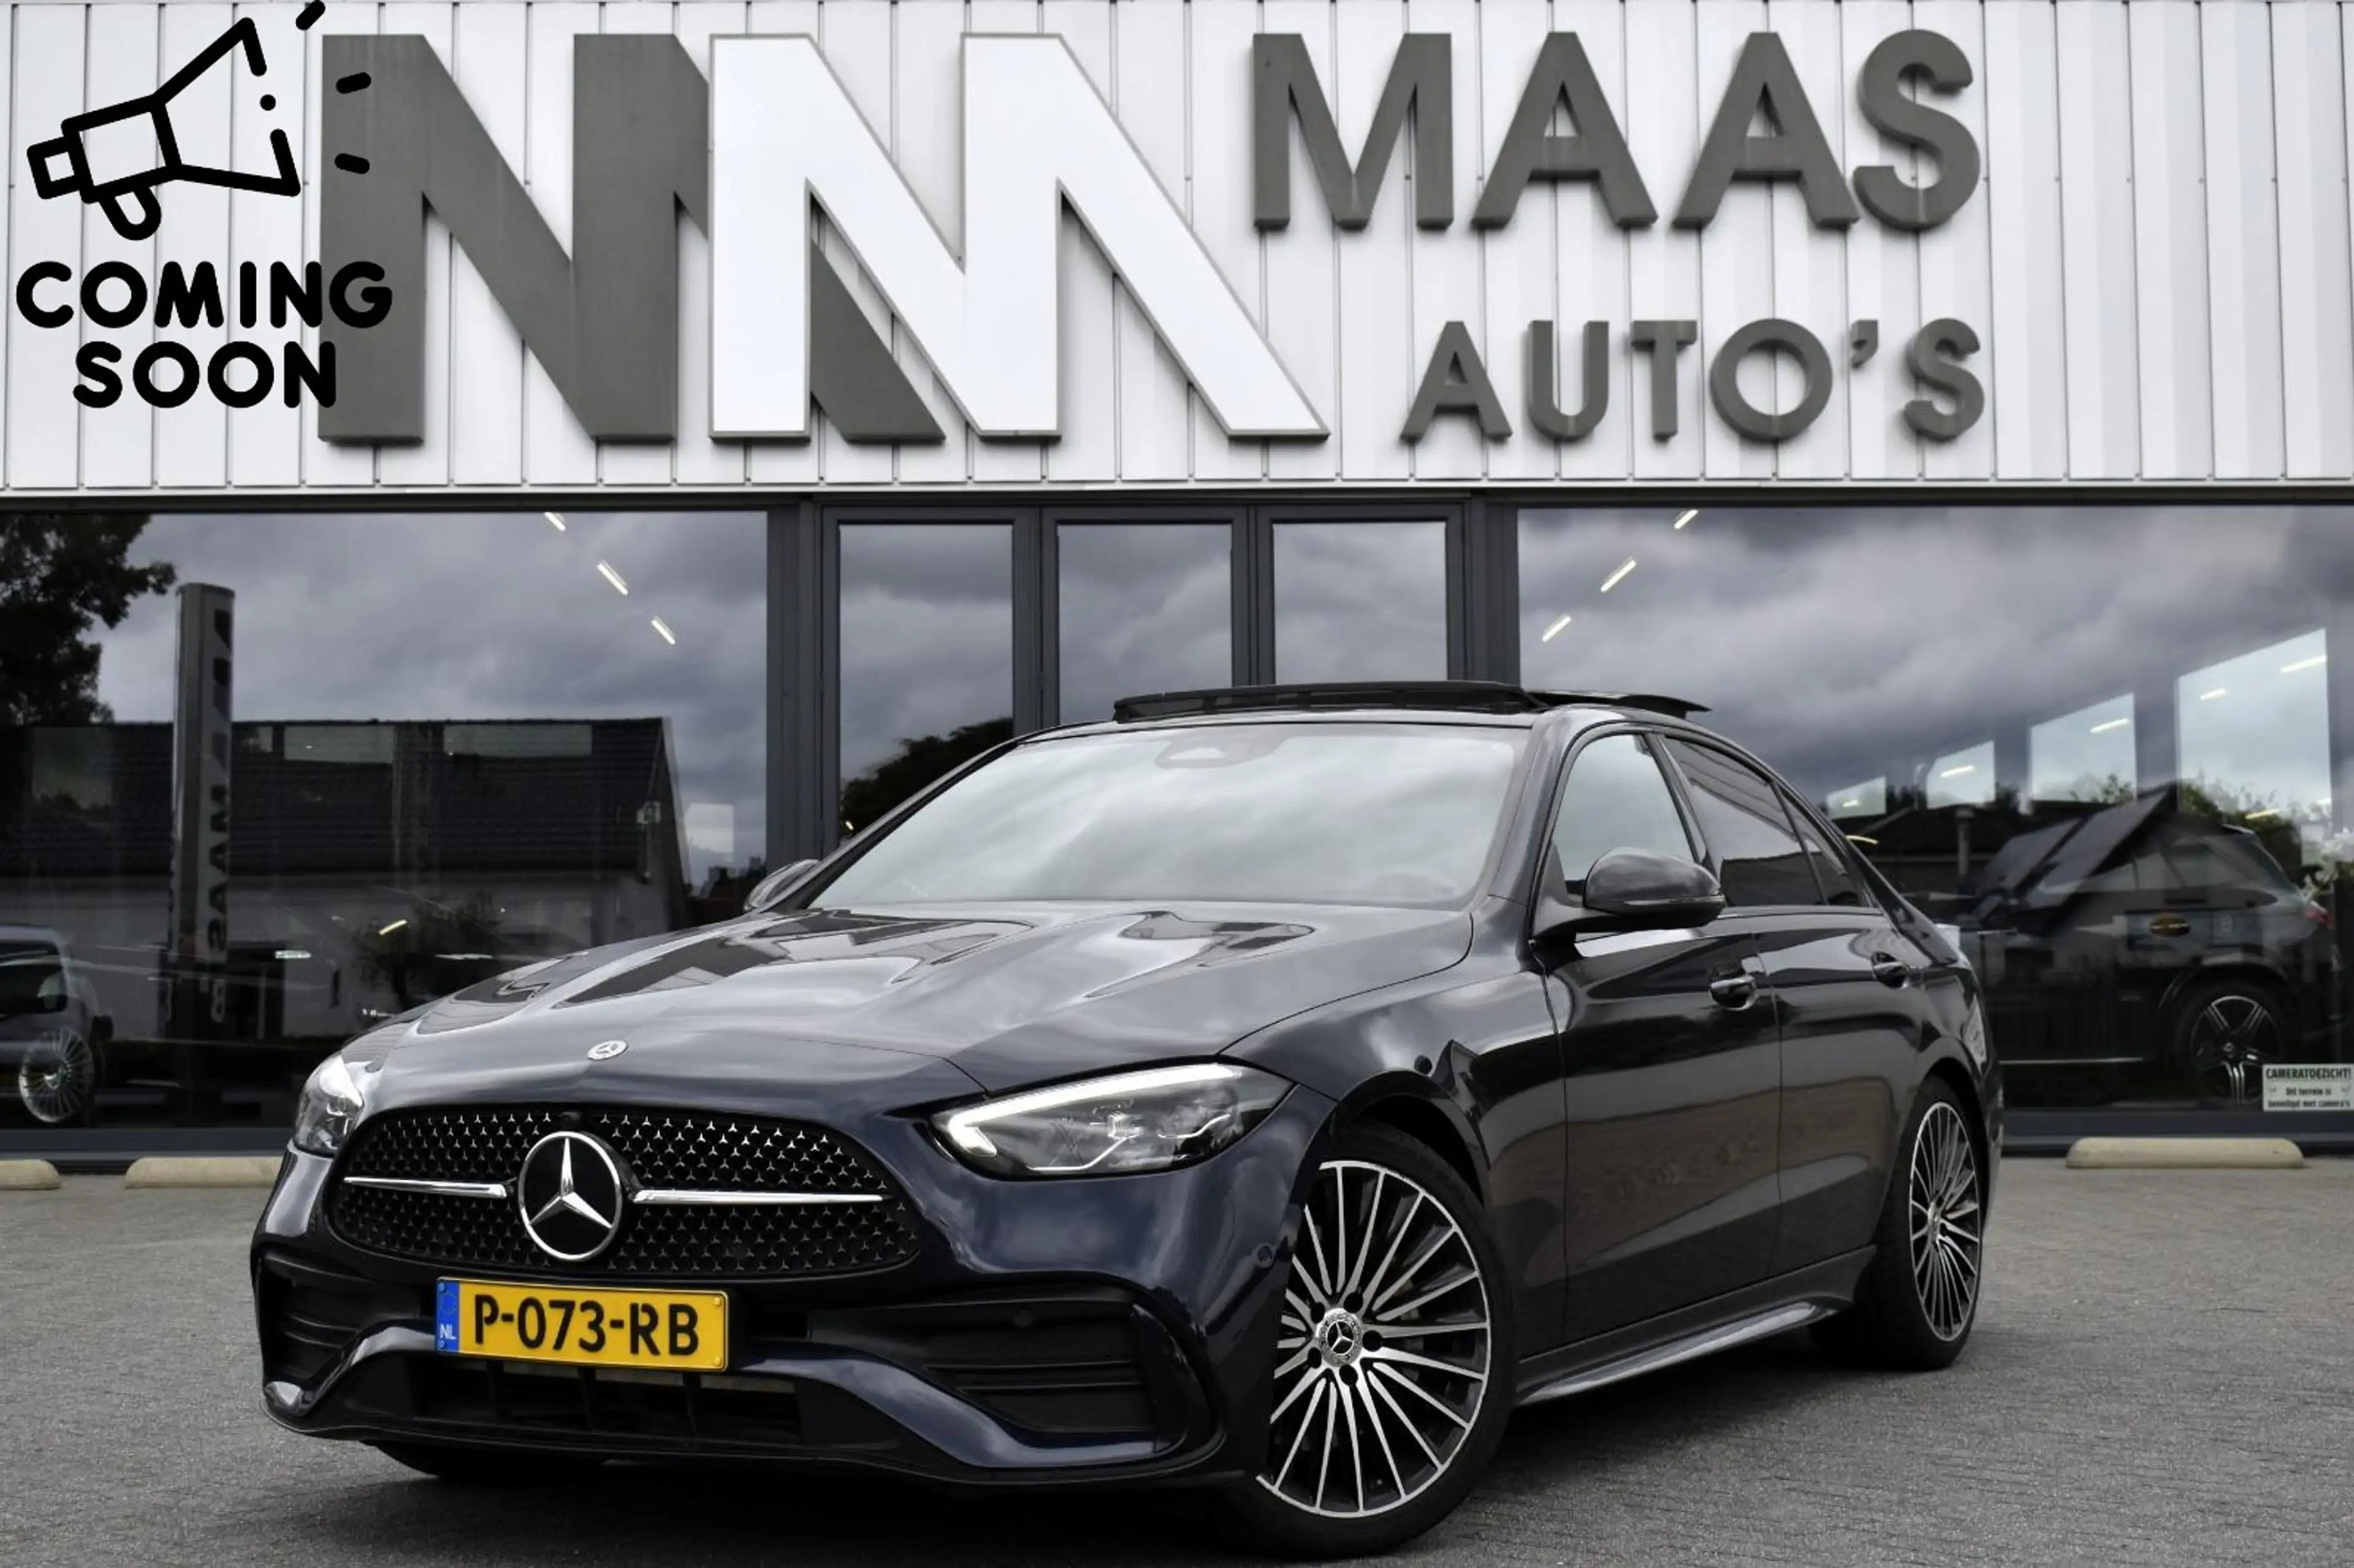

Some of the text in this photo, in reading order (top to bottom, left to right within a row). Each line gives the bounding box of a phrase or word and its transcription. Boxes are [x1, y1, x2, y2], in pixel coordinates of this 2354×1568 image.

[1252, 29, 1981, 232] MAAS
[1400, 318, 1985, 442] AUTO'S
[440, 1323, 457, 1341] NL
[474, 1294, 699, 1357] P-073-RB
